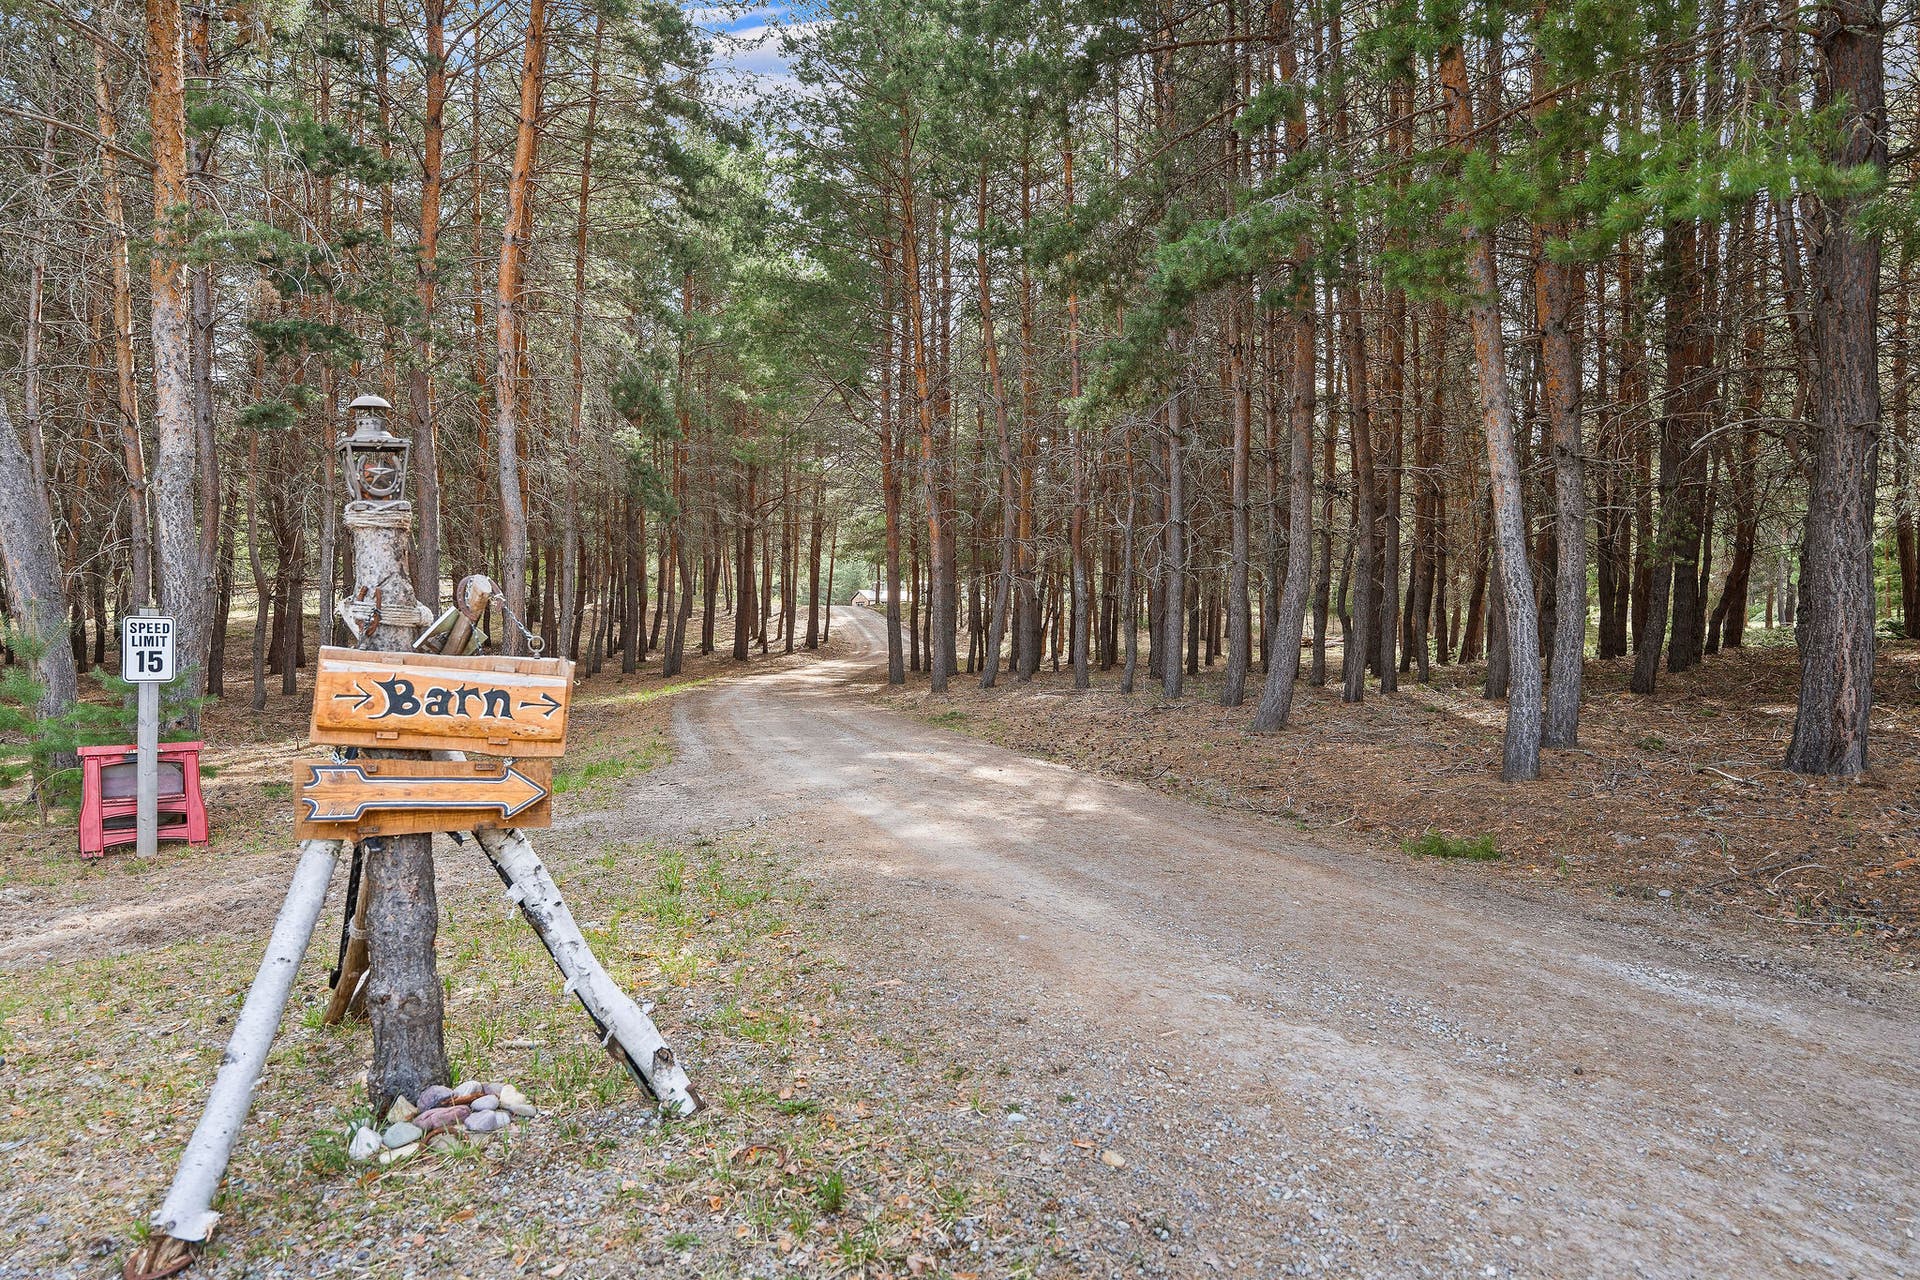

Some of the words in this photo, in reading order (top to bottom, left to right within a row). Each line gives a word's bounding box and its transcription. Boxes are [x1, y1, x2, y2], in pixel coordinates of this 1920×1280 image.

[129, 622, 170, 634] SPEED
[131, 635, 168, 647] LIMIT
[136, 650, 163, 673] 15
[367, 673, 516, 720] Barn
